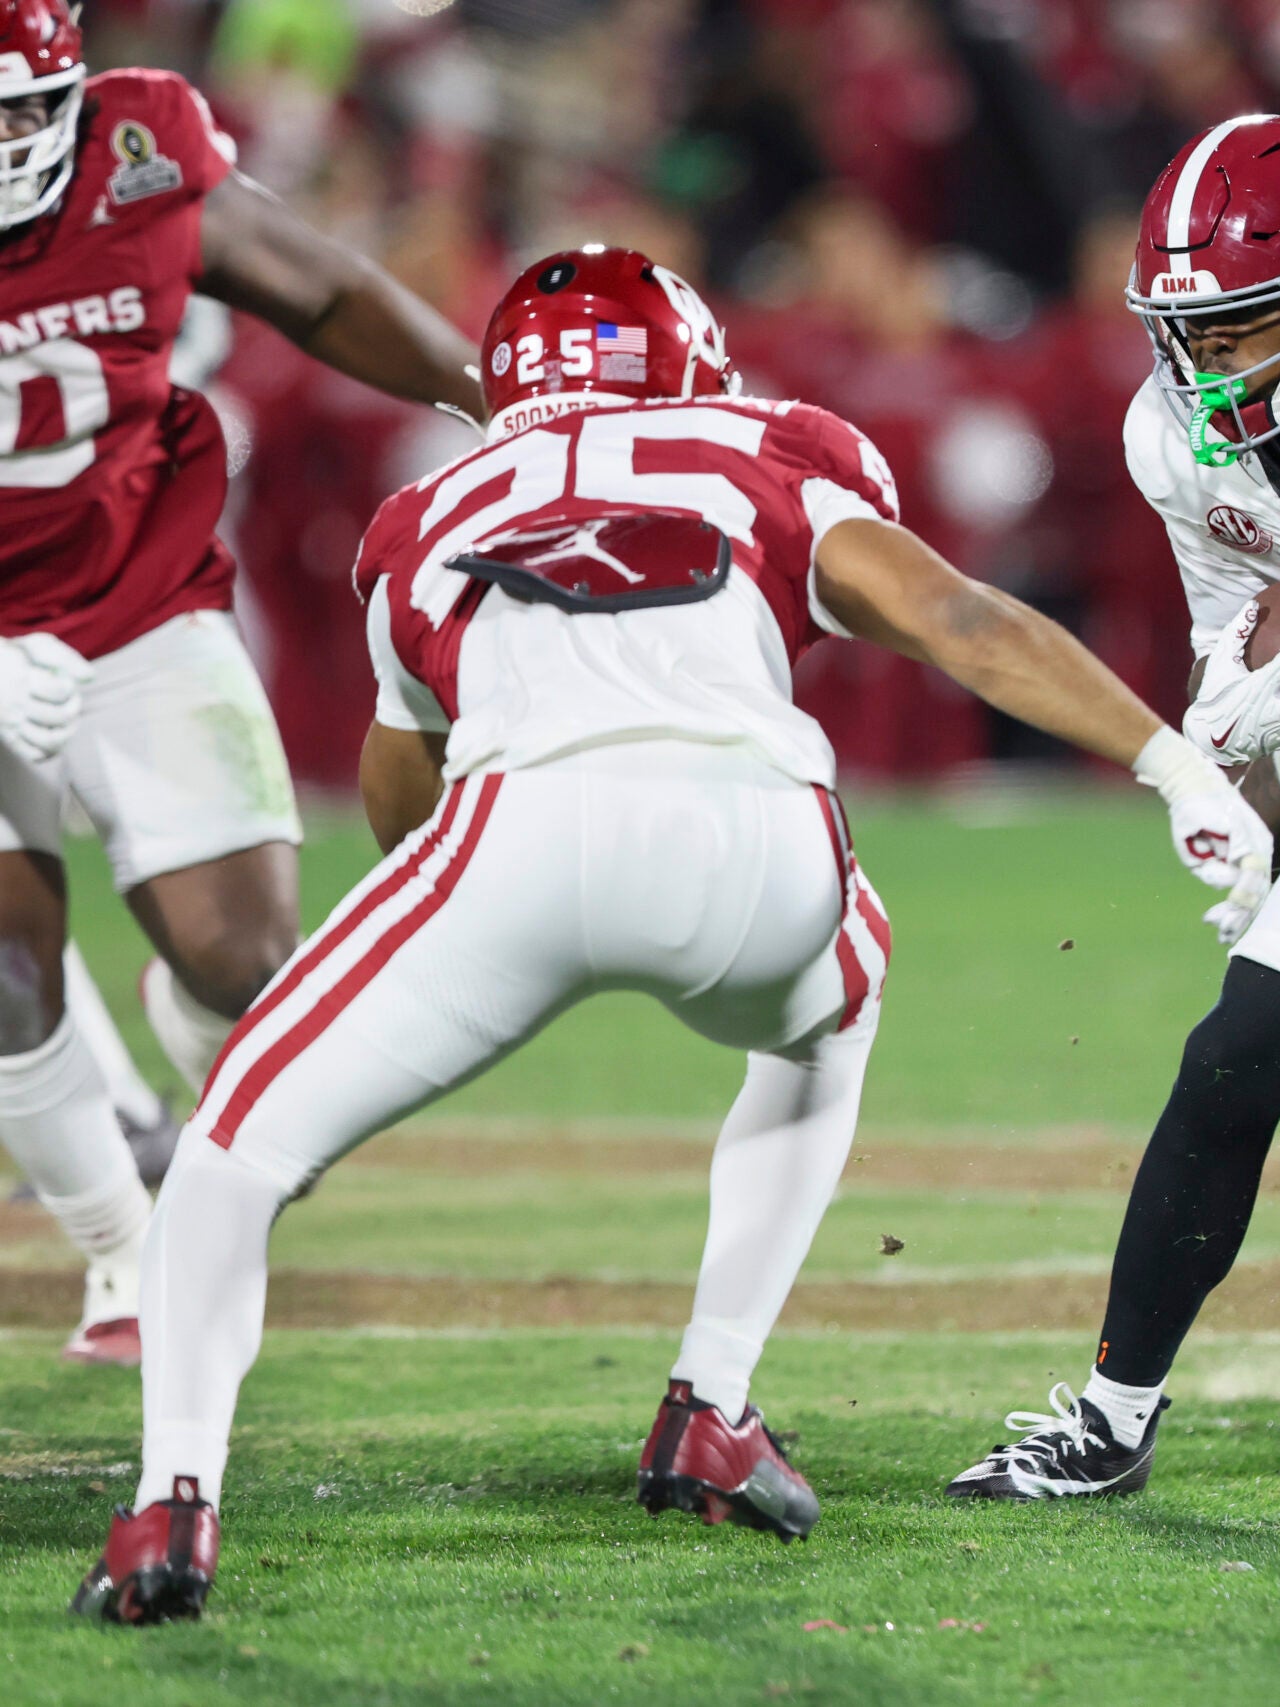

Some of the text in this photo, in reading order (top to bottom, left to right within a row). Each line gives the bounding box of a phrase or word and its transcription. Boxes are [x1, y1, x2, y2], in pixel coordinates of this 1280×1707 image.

[1161, 277, 1197, 293] BAMA
[516, 328, 594, 385] 25
[504, 401, 598, 434] SOON
[410, 406, 768, 632] 25
[1208, 507, 1257, 545] SEC
